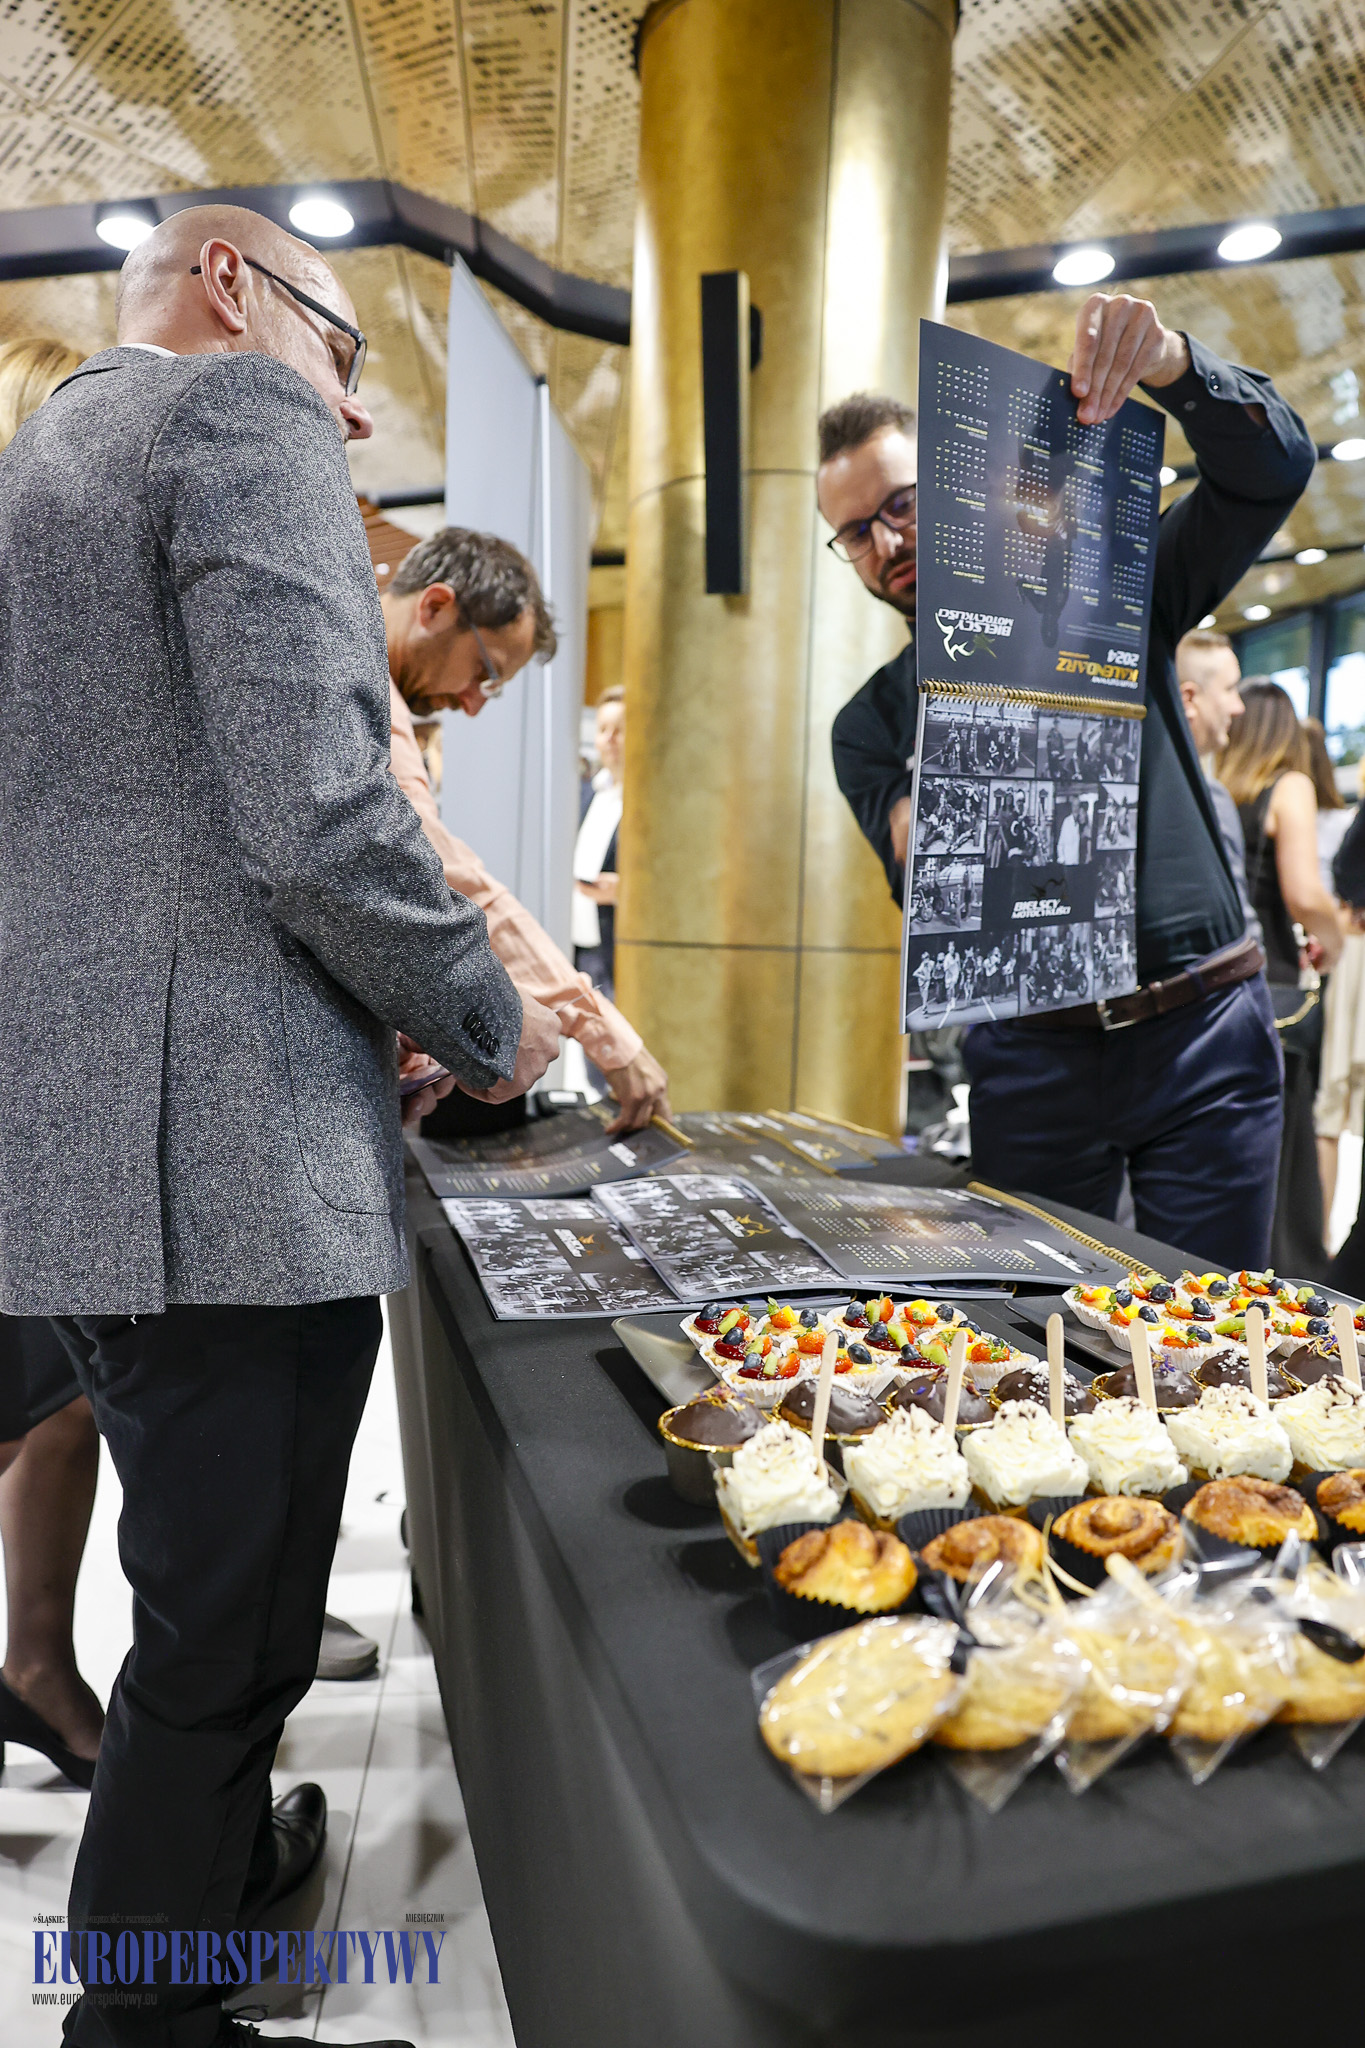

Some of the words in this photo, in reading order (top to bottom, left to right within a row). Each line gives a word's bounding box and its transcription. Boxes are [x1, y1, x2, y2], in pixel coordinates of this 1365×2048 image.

[955, 616, 1013, 637] BIELSCY
[1106, 649, 1139, 667] 2024
[1057, 658, 1139, 682] KALENDARZ
